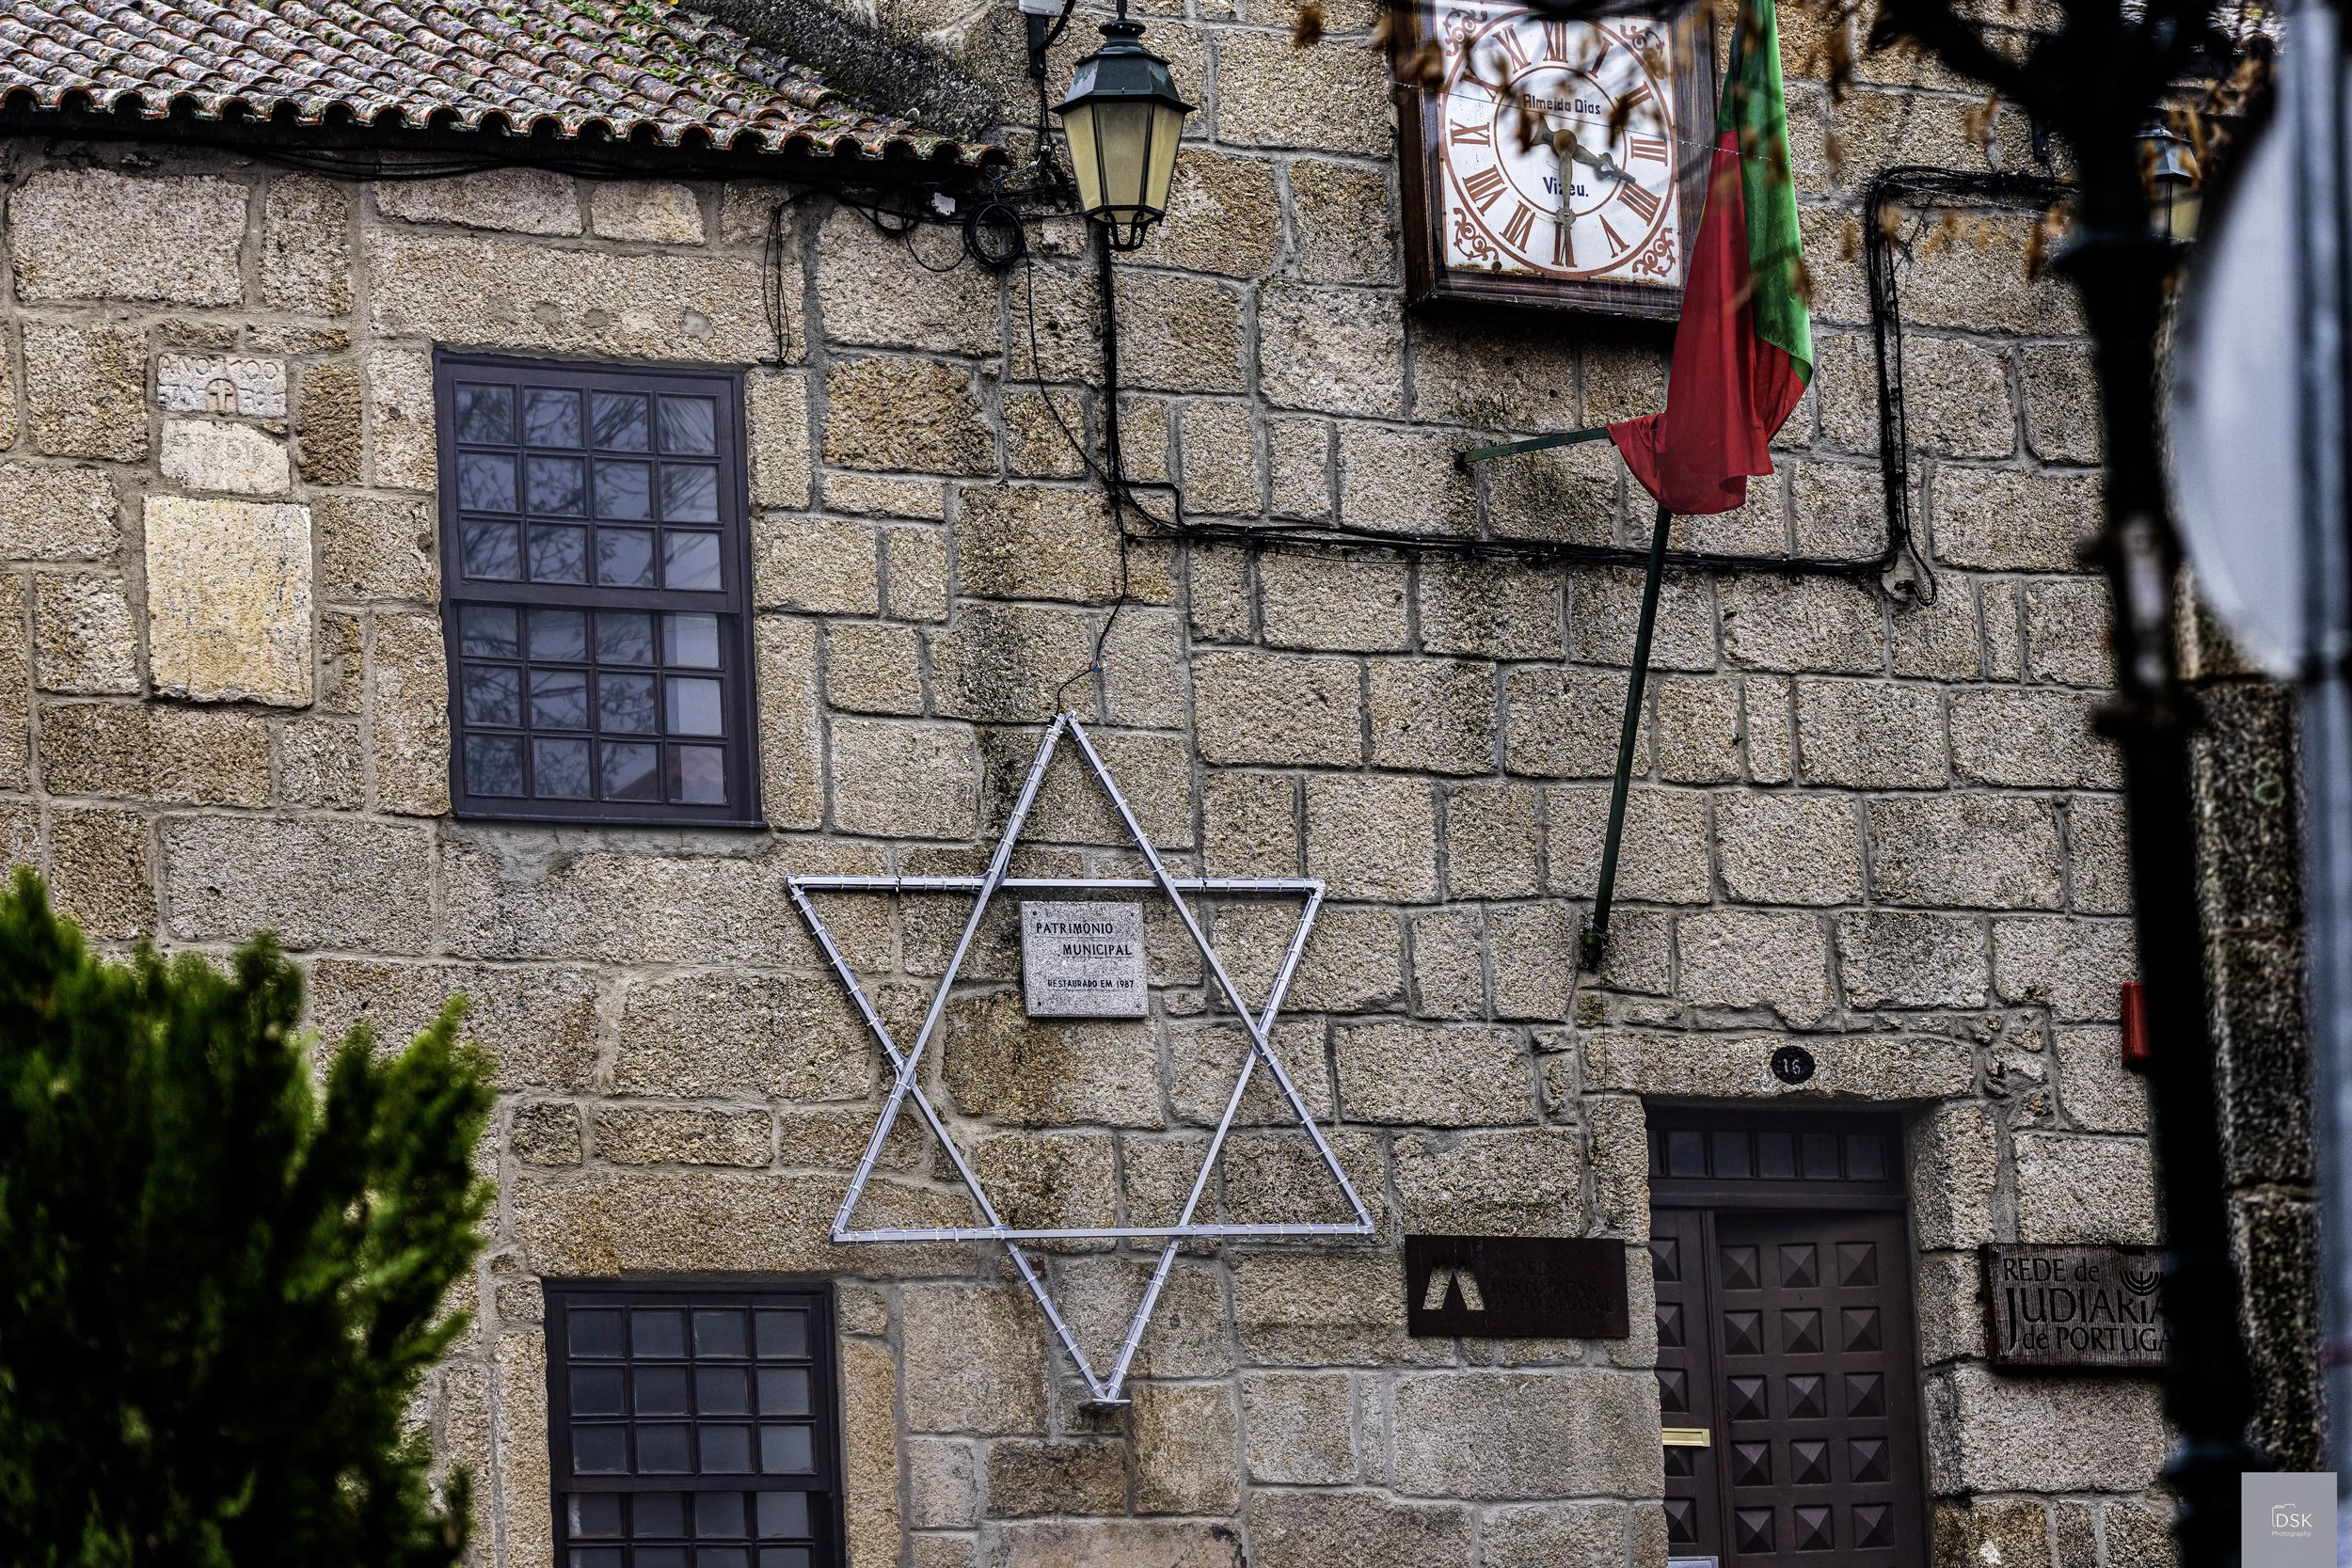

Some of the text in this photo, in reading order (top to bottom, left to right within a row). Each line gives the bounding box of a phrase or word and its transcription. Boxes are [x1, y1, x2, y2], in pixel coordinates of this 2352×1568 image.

[1492, 24, 1532, 74] XI
[1541, 19, 1568, 63] XII
[1588, 37, 1613, 78] I
[1522, 93, 1601, 115] Almeida Dias
[1629, 135, 1668, 166] III
[1599, 214, 1630, 259] V
[1062, 943, 1132, 956] MUNICIPAL
[1047, 979, 1135, 989] RESTAURADO EM 1987
[1783, 1058, 1801, 1074] 16
[2003, 1258, 2100, 1283] REDE de
[2023, 1325, 2172, 1352] de PORTUGA
